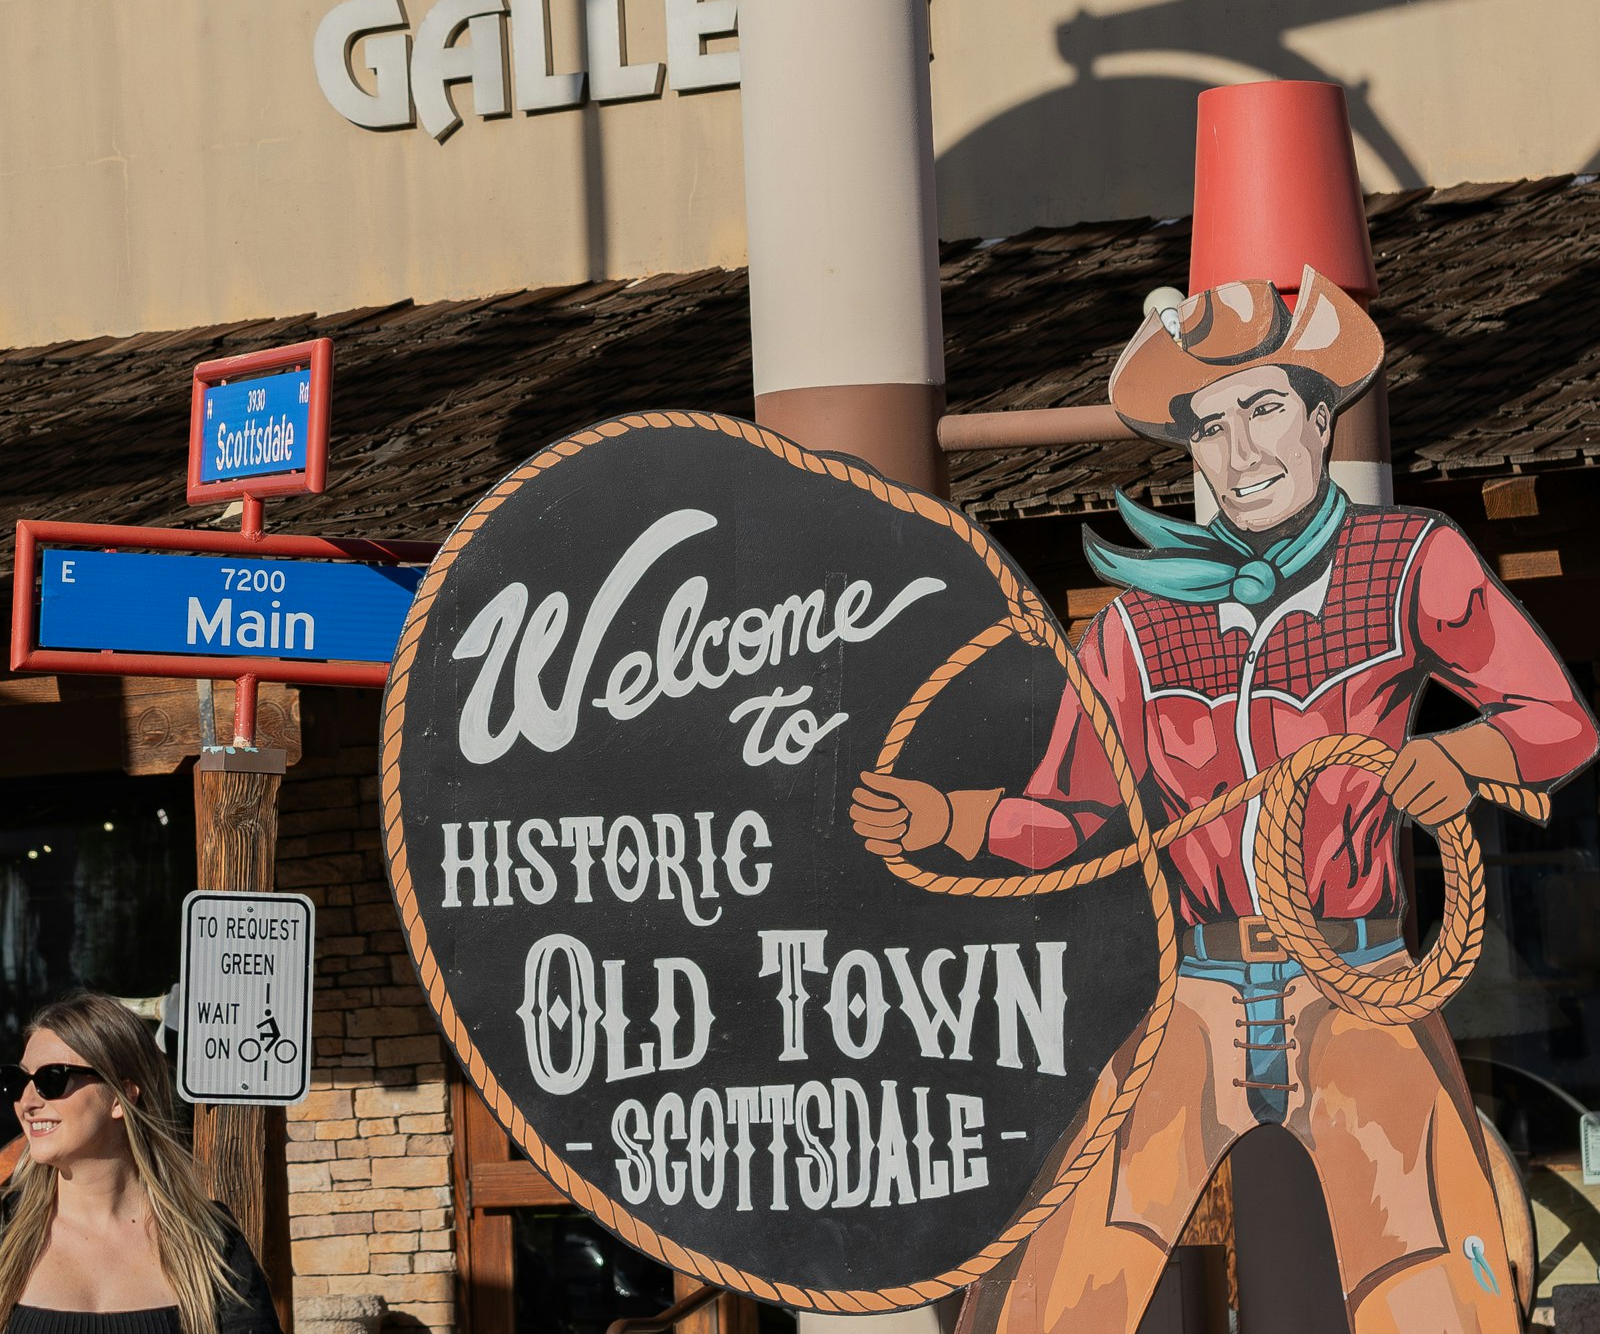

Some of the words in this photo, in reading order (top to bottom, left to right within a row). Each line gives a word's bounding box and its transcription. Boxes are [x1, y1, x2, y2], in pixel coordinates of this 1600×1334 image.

[206, 398, 213, 420] N
[247, 388, 266, 413] 3930
[298, 380, 310, 404] Rd
[215, 413, 294, 471] Scottsdale
[61, 560, 76, 583] E
[220, 568, 286, 593] 7200
[186, 596, 315, 651] Main
[452, 508, 947, 765] Welcome
[441, 810, 773, 926] HISTORIC
[197, 916, 218, 939] TO
[226, 917, 300, 941] REQUEST
[221, 953, 275, 976] GREEN
[197, 1002, 241, 1025] WAIT
[516, 934, 715, 1096] OLD
[757, 929, 1068, 1077] TOWN
[205, 1037, 230, 1060] ON
[611, 1078, 990, 1212] SCOTTSDALE
